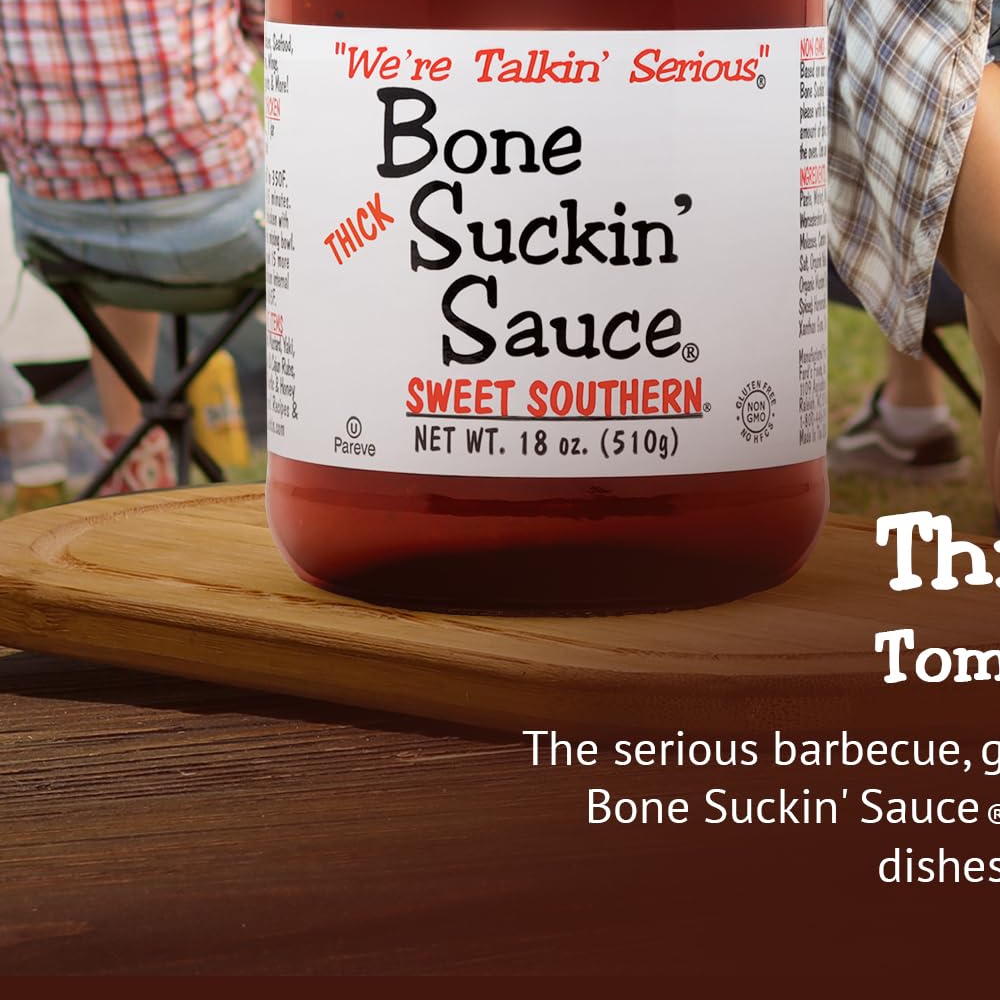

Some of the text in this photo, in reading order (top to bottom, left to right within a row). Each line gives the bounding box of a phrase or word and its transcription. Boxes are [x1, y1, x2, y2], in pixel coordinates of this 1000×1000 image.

[474, 46, 609, 84] Talkin'
[376, 87, 582, 178] Bone
[323, 192, 395, 265] THICK
[410, 180, 693, 272] Suckin'
[406, 376, 516, 417] SWEET
[736, 380, 762, 409] GLUTEN
[762, 381, 777, 407] FREE
[747, 401, 766, 412] NON
[740, 423, 774, 444] NO HFCS
[746, 412, 766, 424] GMO
[334, 436, 376, 457] Pareve
[414, 424, 679, 459] NET WT. 18 oz. (510g)
